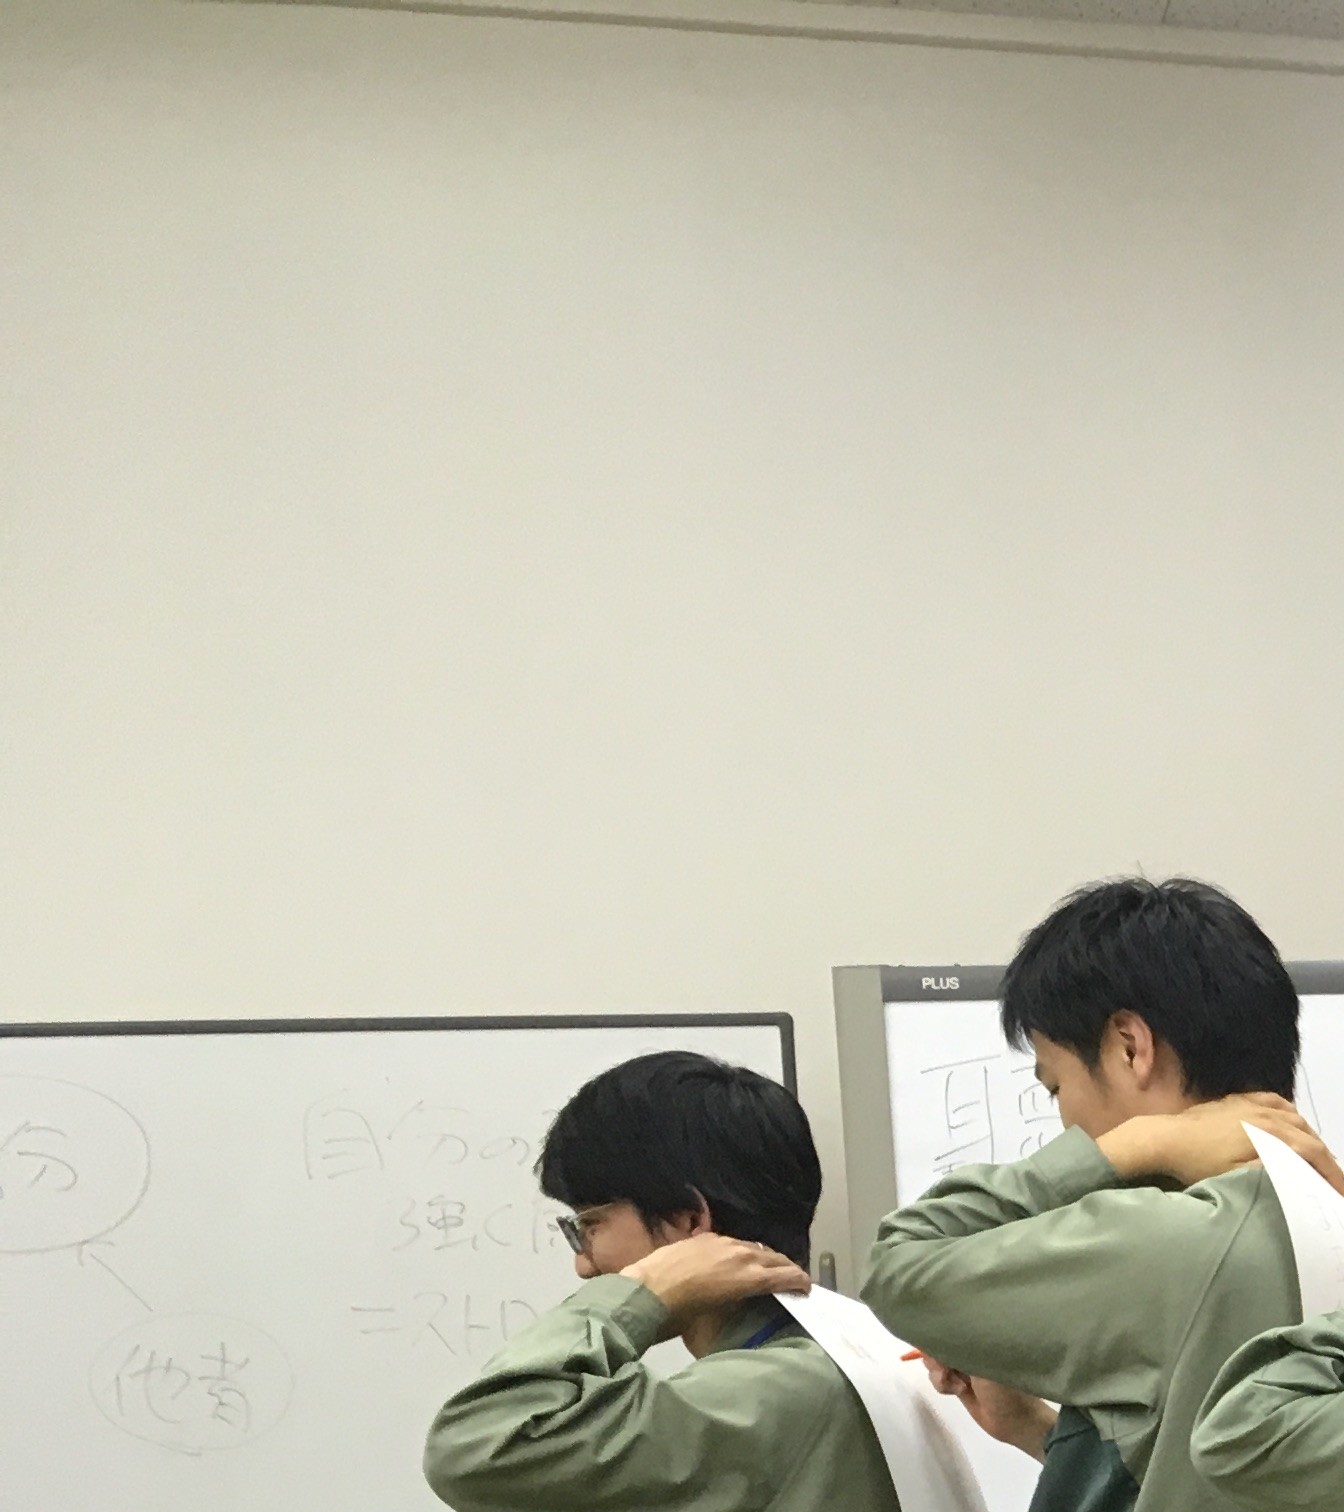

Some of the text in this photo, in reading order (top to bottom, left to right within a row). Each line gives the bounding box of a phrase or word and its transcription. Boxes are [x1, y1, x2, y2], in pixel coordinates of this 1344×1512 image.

[922, 976, 959, 989] PLUS
[301, 1087, 560, 1181] 自分の
[115, 1341, 252, 1434] 他者
